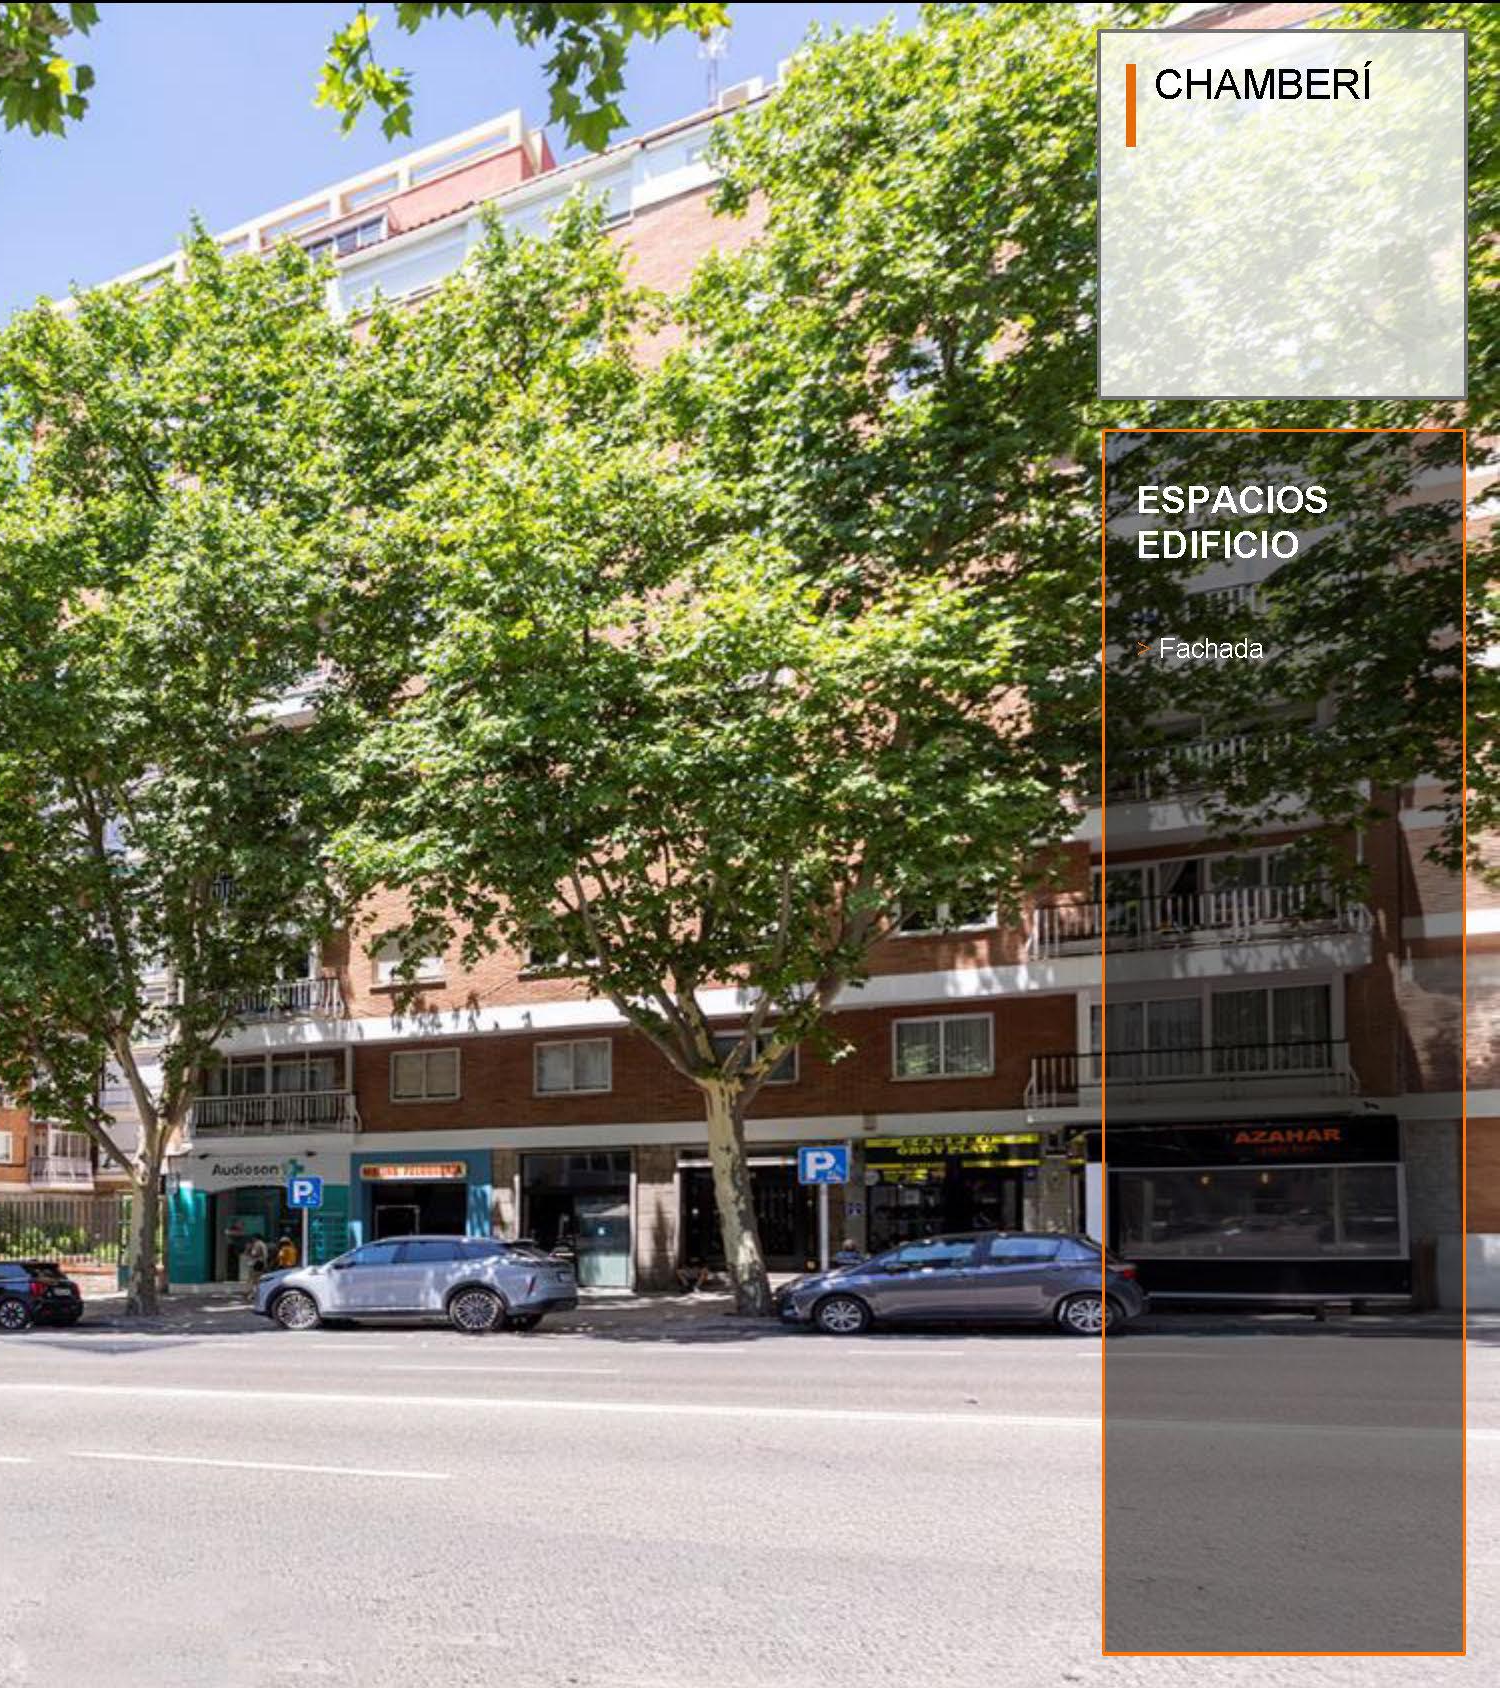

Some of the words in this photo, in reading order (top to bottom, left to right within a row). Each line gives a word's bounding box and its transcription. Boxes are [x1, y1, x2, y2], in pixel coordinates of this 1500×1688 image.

[1235, 1128, 1341, 1144] AZAHAR
[211, 1163, 279, 1176] Audioson
[805, 1151, 836, 1180] P
[293, 1180, 313, 1204] P
